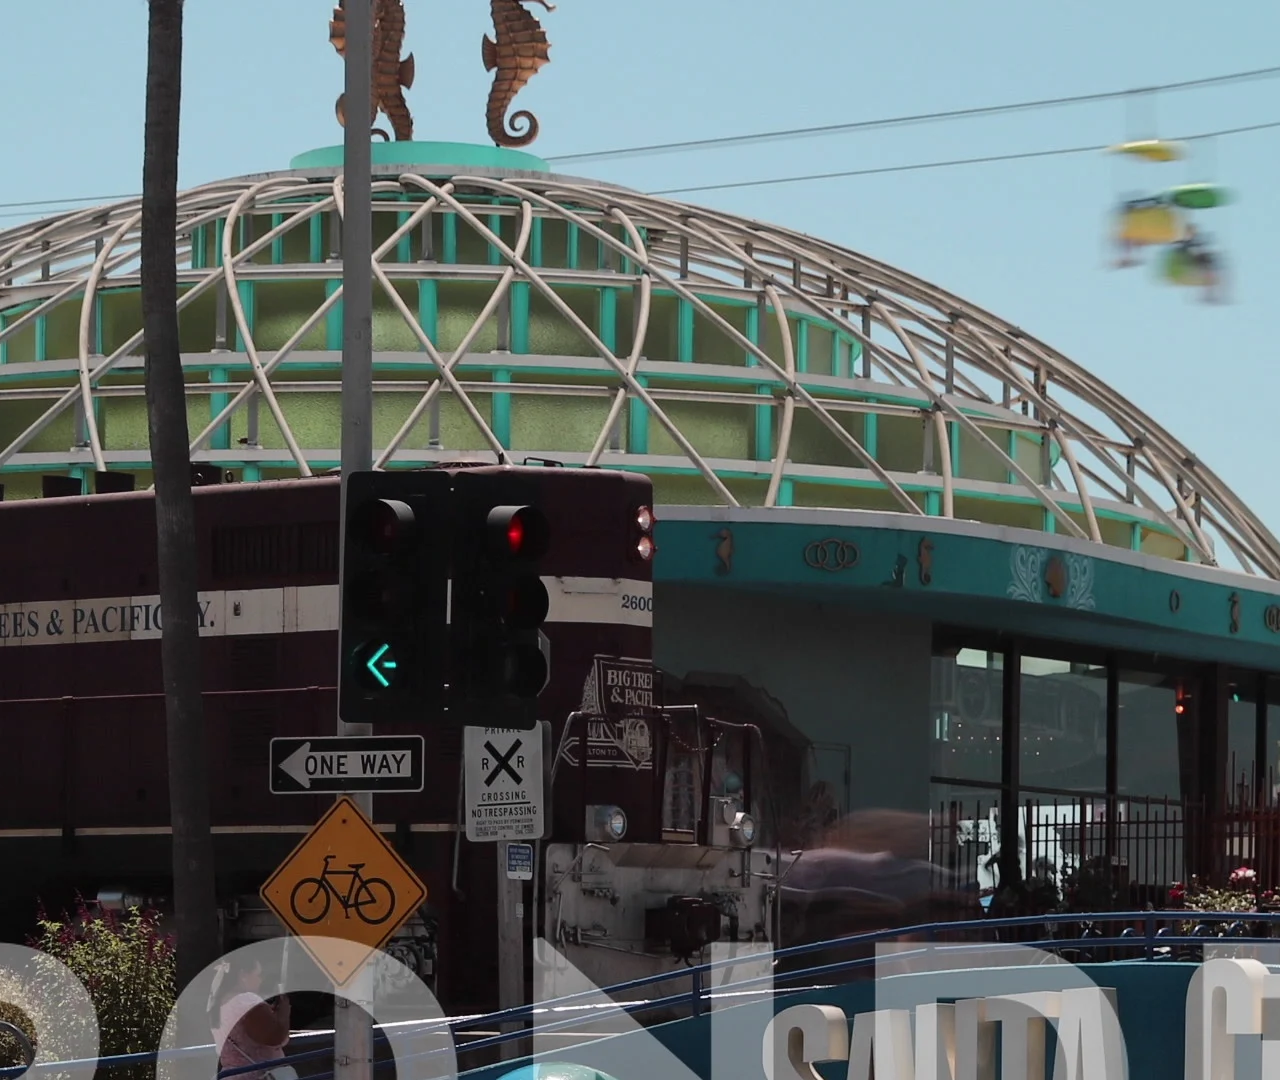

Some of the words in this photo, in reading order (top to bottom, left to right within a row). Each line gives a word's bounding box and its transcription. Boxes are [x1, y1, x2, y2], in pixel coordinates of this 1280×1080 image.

[621, 594, 653, 612] 2600
[45, 609, 65, 636] &
[196, 600, 216, 628] Y.
[607, 670, 631, 687] BIG
[631, 672, 652, 689] TRE
[610, 687, 624, 704] &
[587, 748, 606, 756] LTON
[304, 754, 348, 775] ONE
[360, 753, 407, 774] WAY
[481, 757, 489, 770] R
[517, 755, 525, 768] R
[481, 790, 527, 802] CROSSING
[472, 808, 482, 818] NO
[484, 805, 537, 817] TRESPASSING
